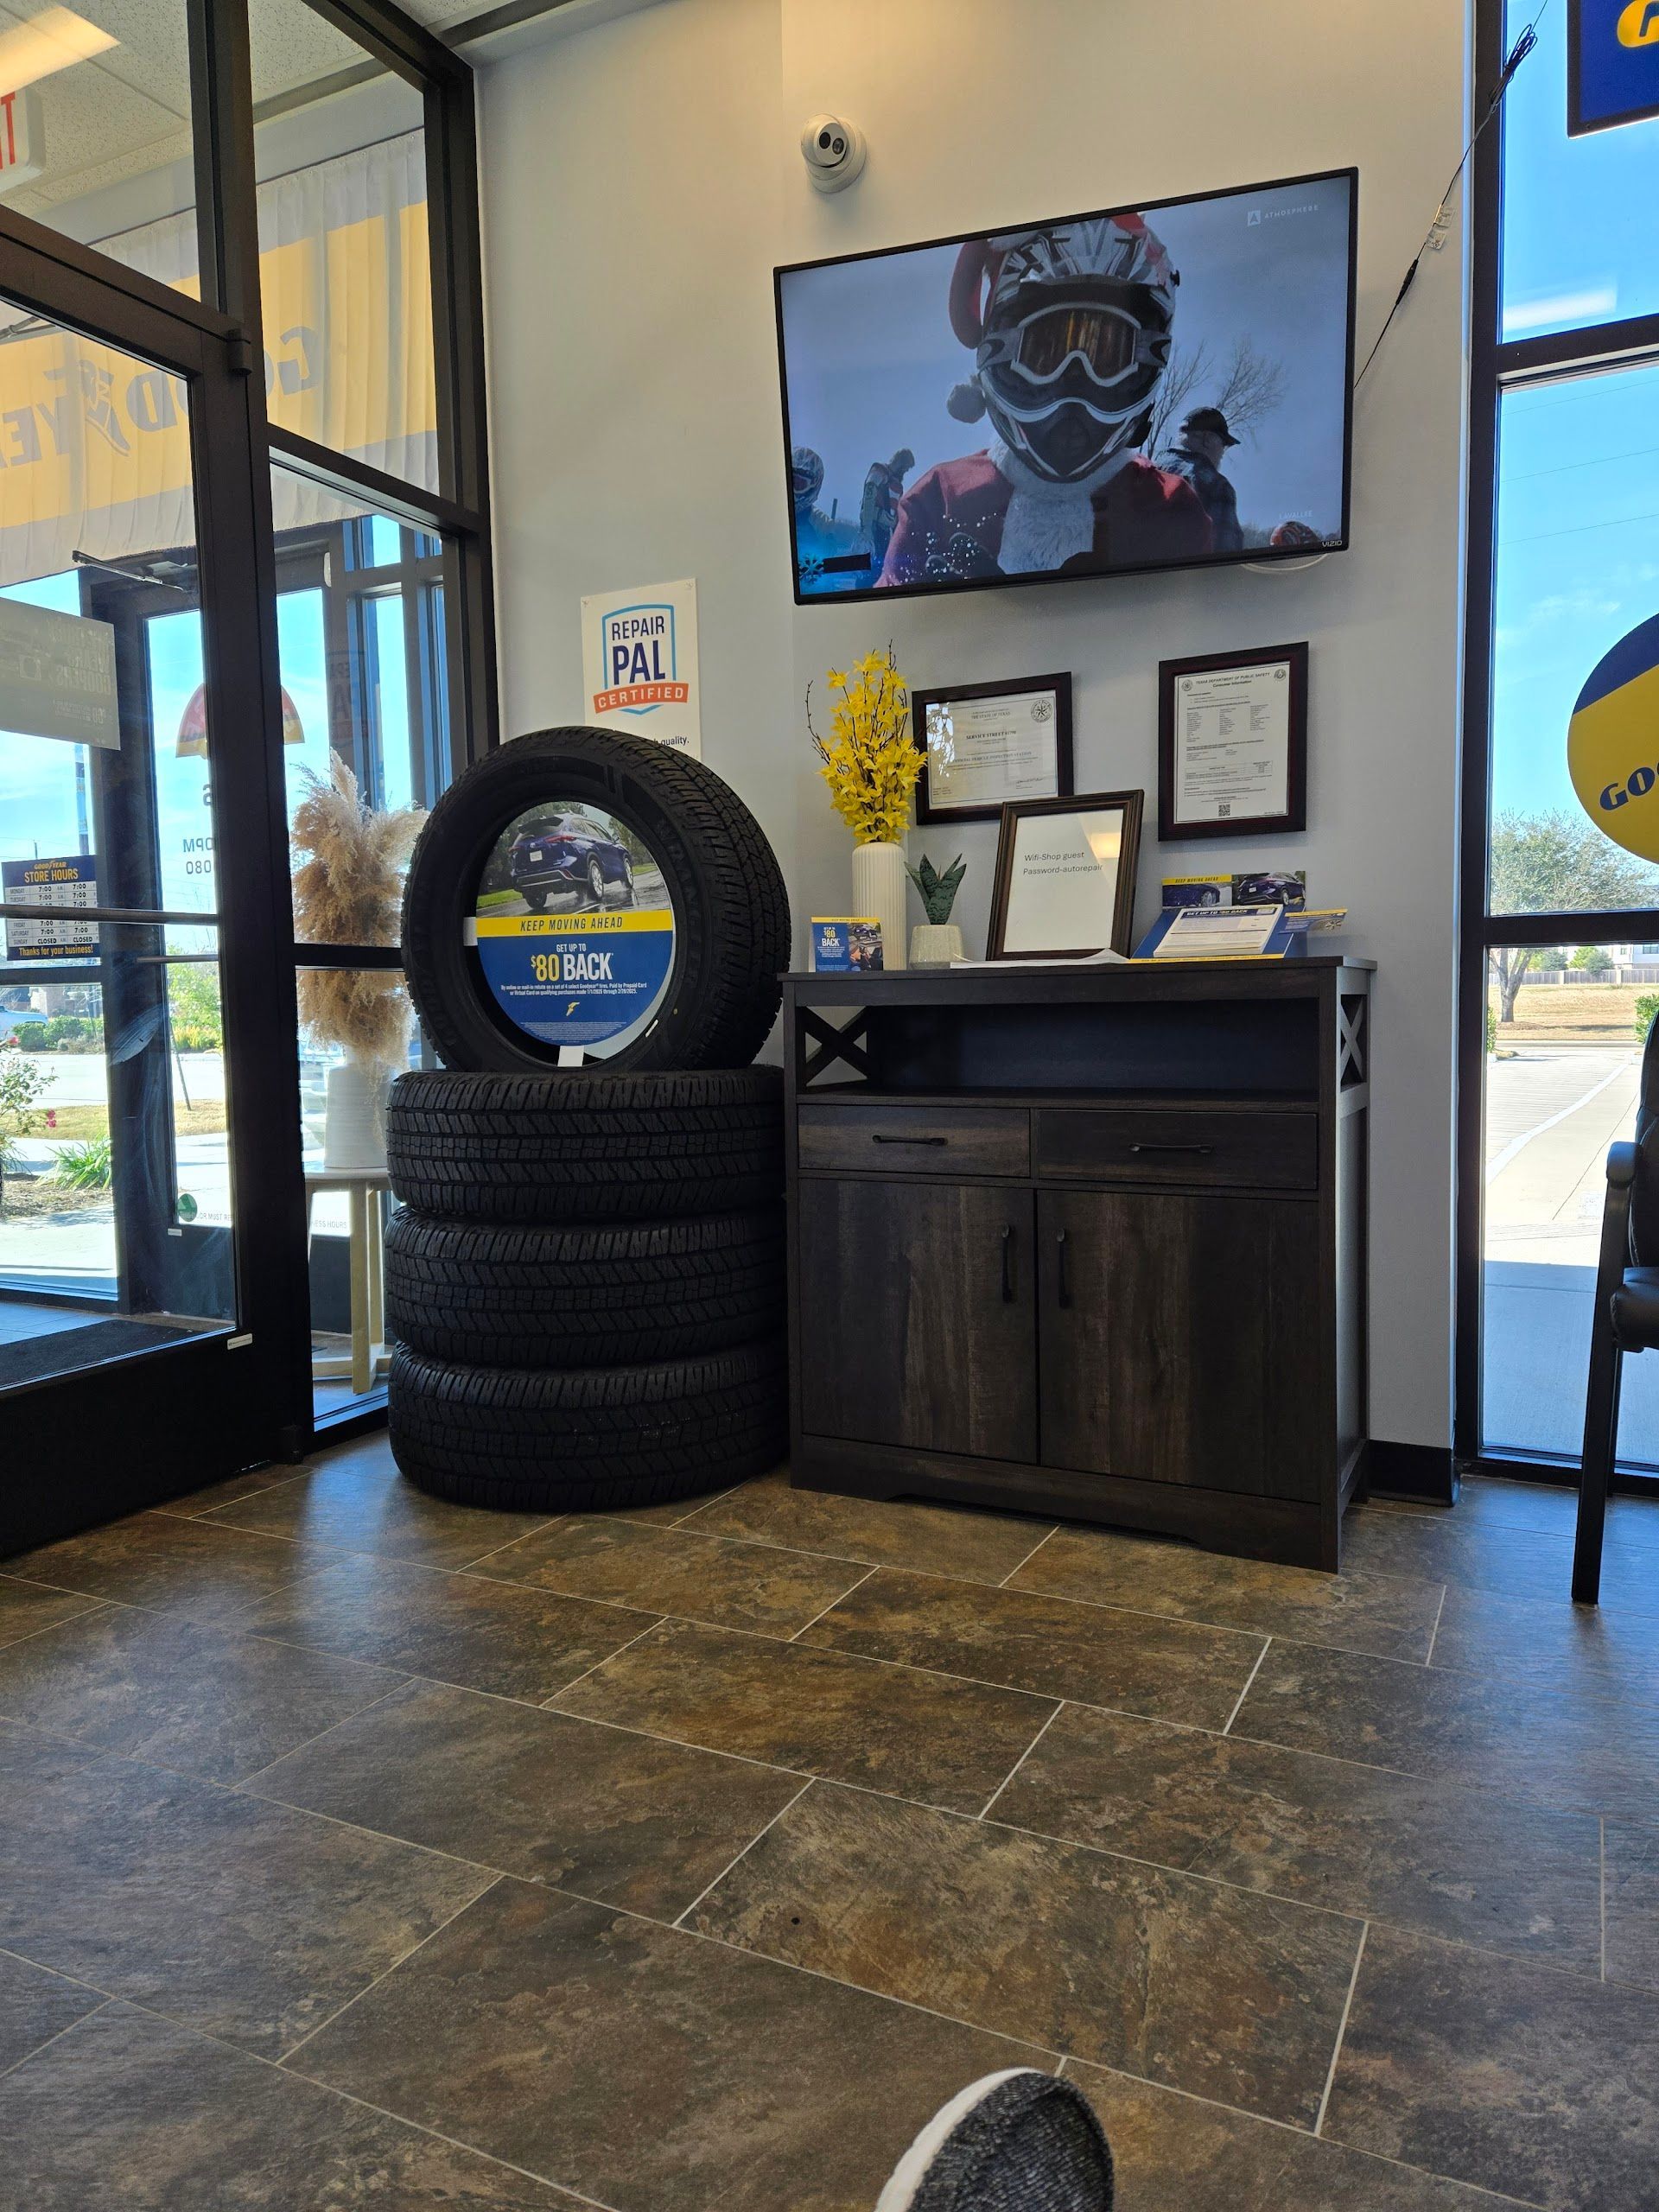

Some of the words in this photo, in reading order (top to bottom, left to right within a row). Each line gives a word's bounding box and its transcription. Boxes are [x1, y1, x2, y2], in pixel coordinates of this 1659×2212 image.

[1264, 204, 1319, 219] ATMOSPHERE
[612, 615, 664, 641] REPAIR
[613, 640, 665, 685] PAL
[598, 687, 683, 709] CERTIFIED
[1063, 852, 1084, 861] guest
[34, 861, 67, 870] GOODYEAR
[24, 869, 49, 883] STORE
[51, 868, 79, 881] HOURS
[520, 920, 544, 931] KEEP
[549, 918, 586, 931] MOVING
[590, 917, 623, 929] AHEAD
[19, 947, 40, 957] Thanks
[51, 947, 63, 957] your
[65, 944, 93, 955] business!
[556, 944, 568, 952] GET
[569, 944, 577, 952] UP
[578, 943, 587, 951] TO
[531, 954, 560, 982] $80
